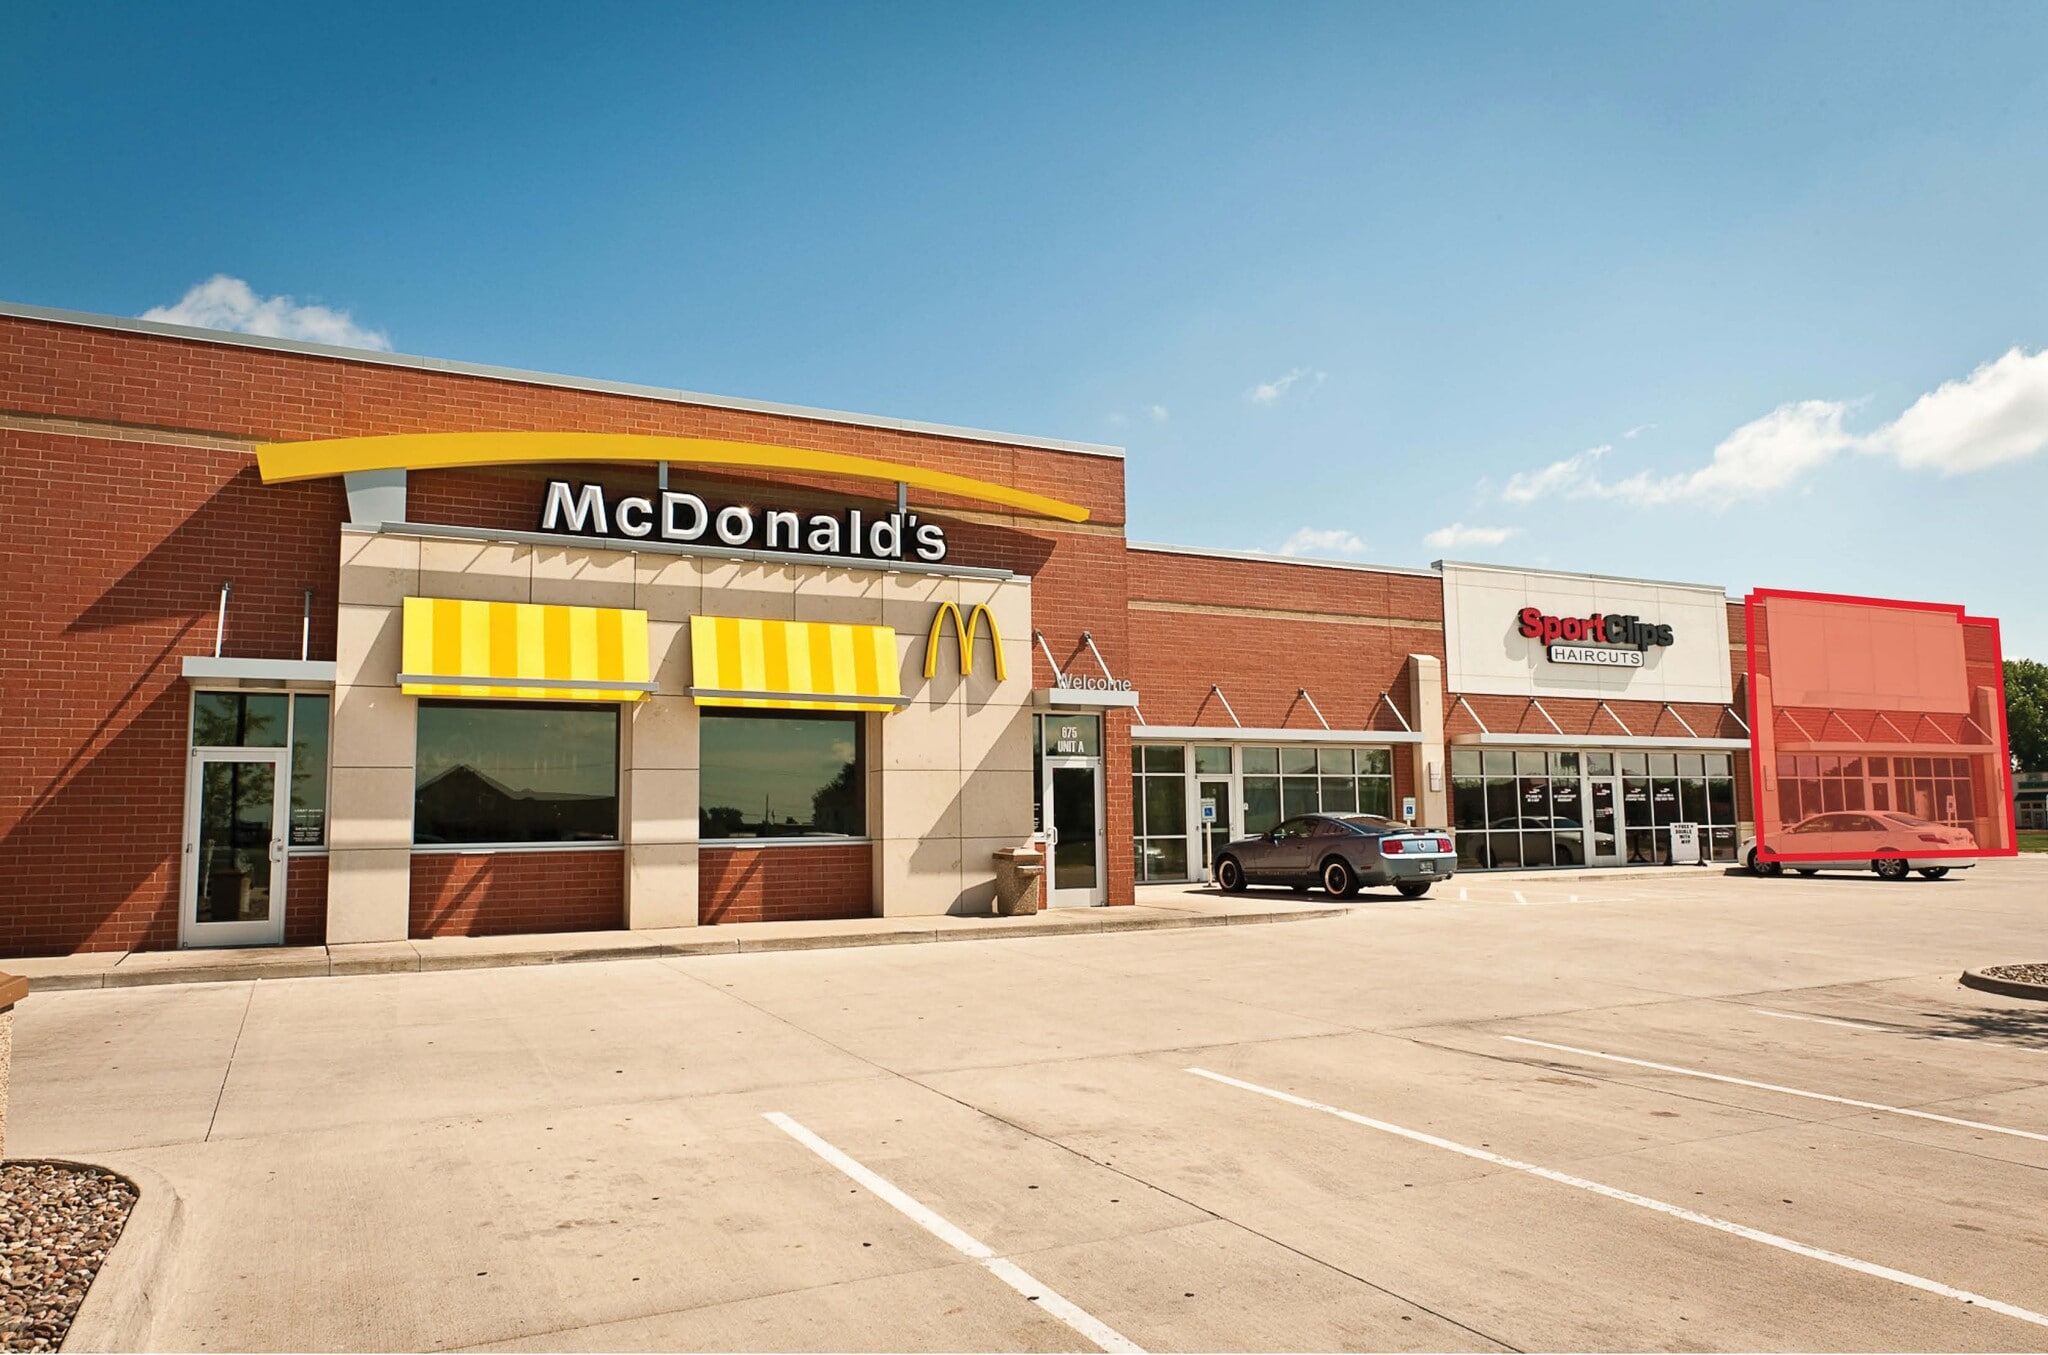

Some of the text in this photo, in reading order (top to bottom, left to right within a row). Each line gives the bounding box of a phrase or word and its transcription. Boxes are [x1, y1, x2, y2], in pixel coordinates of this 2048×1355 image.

[540, 480, 948, 562] McDonald's
[1554, 648, 1641, 665] HAIRCUTS
[1056, 673, 1132, 691] Welcome
[1057, 740, 1085, 753] UNIT A
